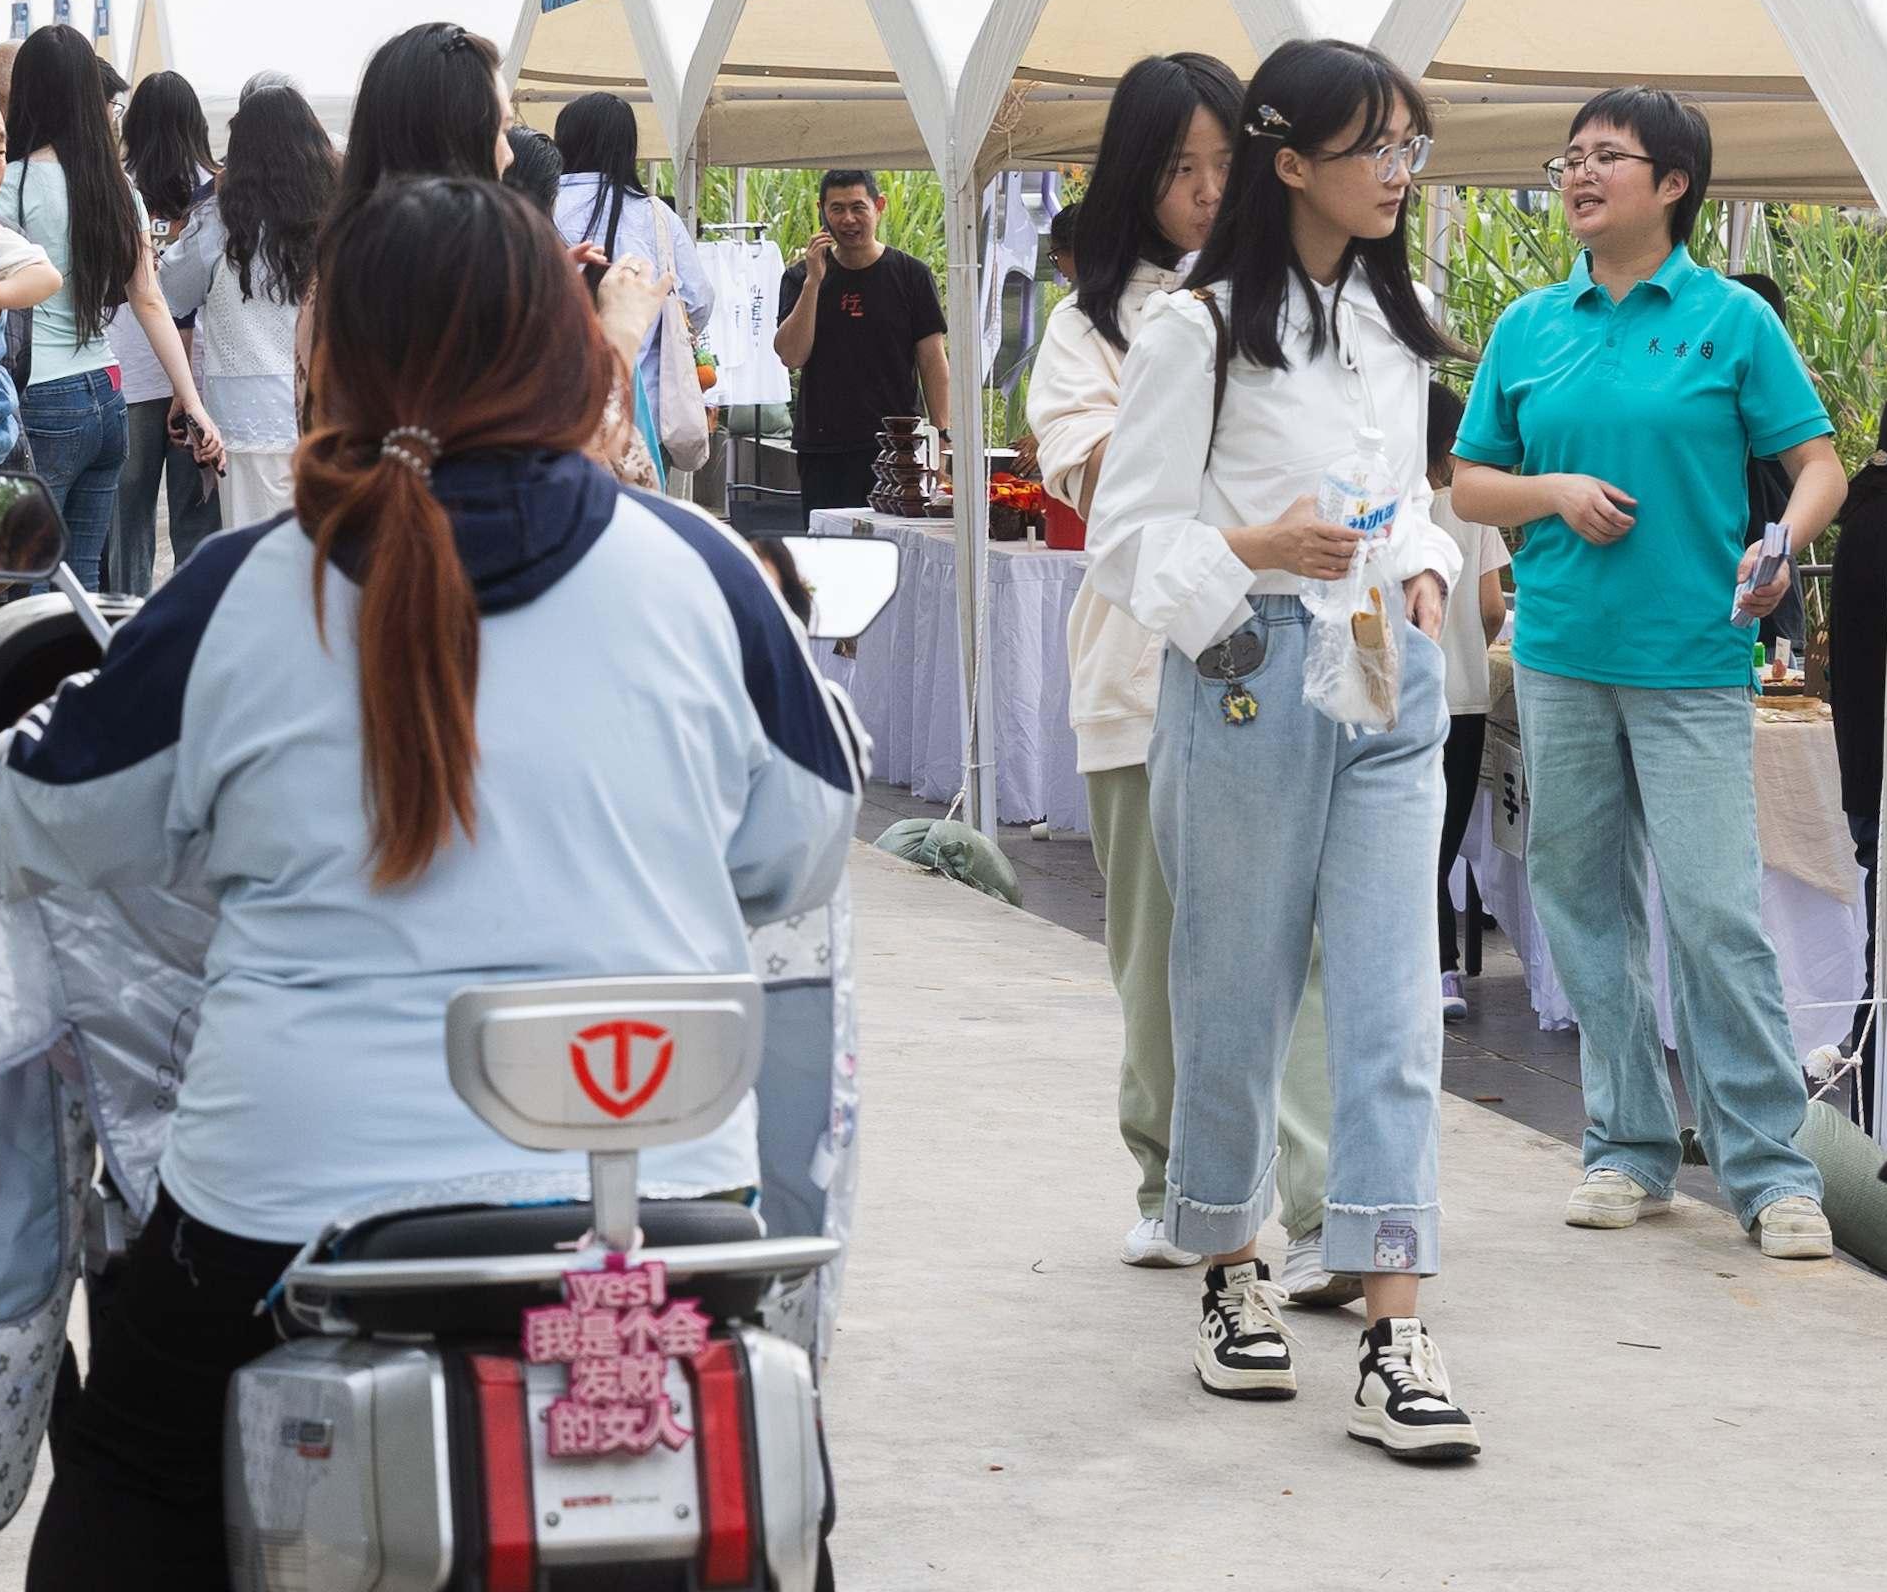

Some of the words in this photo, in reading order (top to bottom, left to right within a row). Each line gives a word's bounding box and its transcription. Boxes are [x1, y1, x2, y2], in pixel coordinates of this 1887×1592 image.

[525, 1298, 711, 1361] 我是个会
[572, 1352, 666, 1402] 发财
[551, 1397, 693, 1453] 的女人
